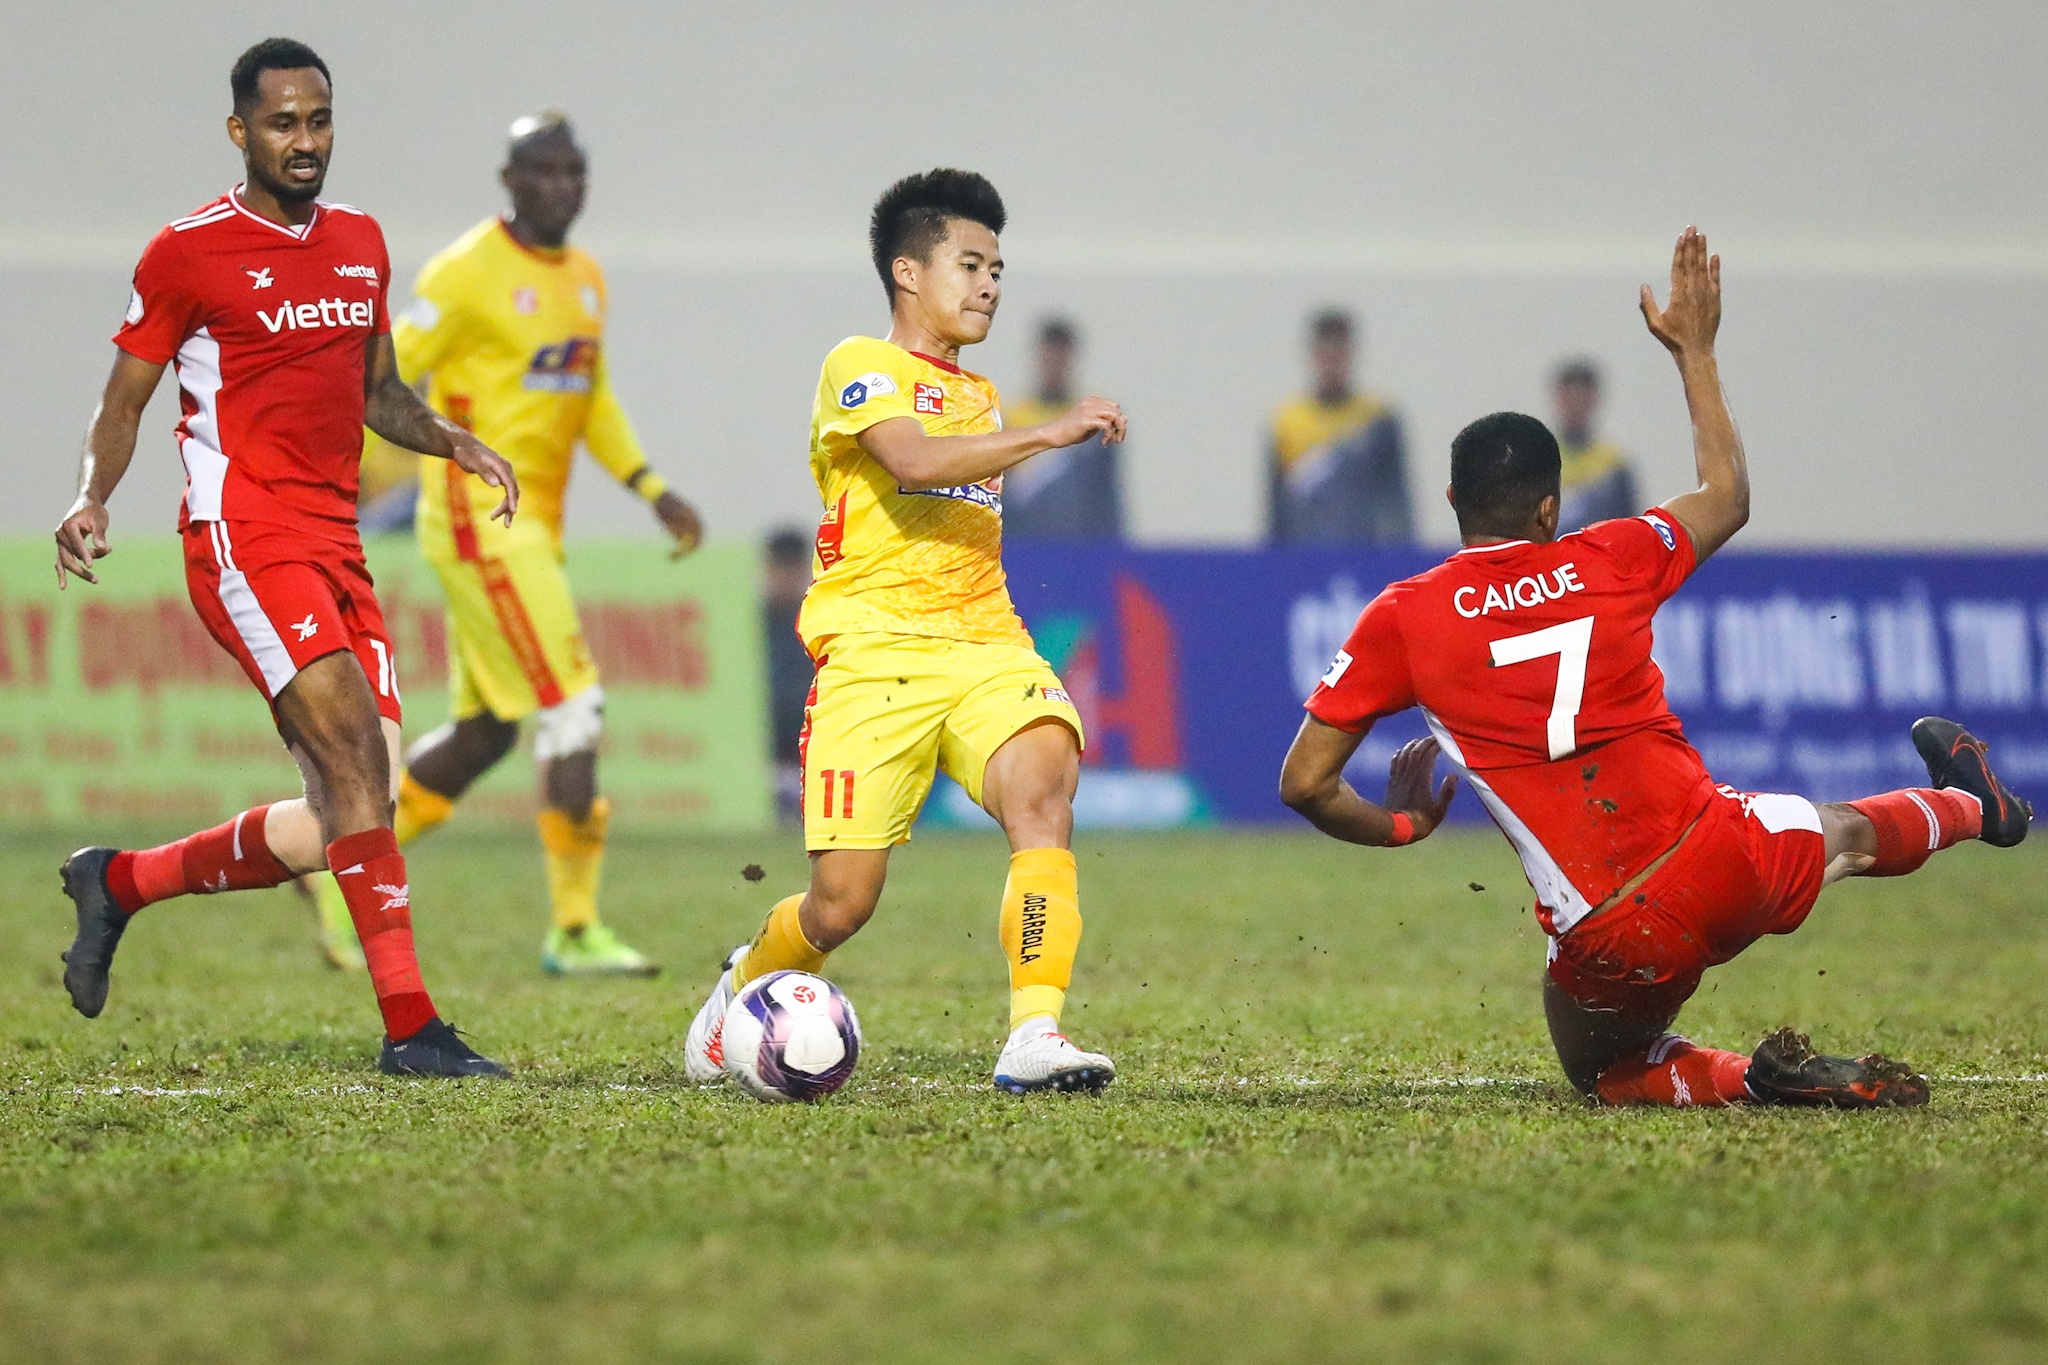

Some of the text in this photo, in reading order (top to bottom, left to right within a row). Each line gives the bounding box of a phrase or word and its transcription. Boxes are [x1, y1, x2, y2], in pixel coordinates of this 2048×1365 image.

[333, 264, 378, 279] viettel
[256, 297, 374, 333] viettel
[1453, 562, 1585, 618] CAIQUE
[1488, 615, 1595, 761] 7
[820, 769, 855, 818] 11
[1020, 892, 1047, 965] JOGARBOLA
